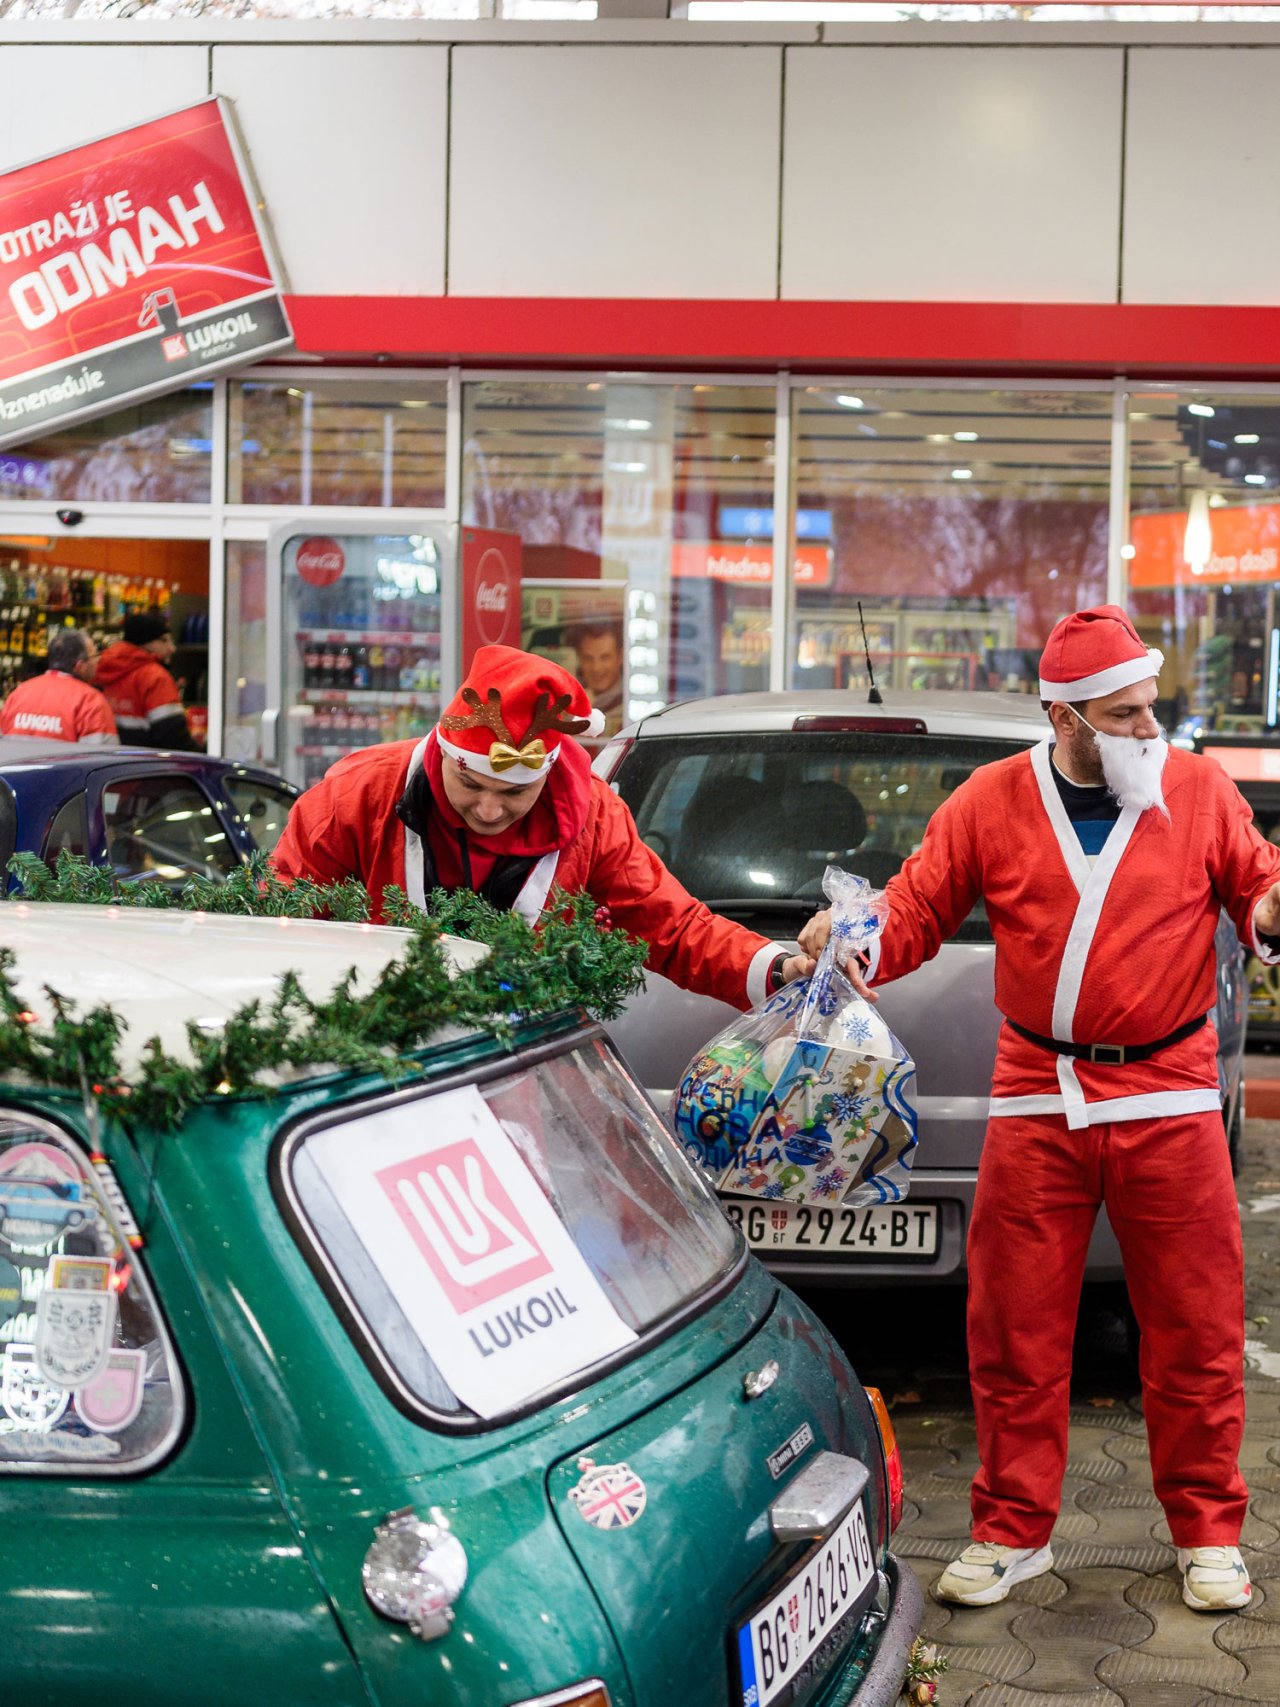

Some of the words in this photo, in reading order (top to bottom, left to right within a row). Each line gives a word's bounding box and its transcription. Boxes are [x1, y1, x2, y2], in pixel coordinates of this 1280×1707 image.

[104, 189, 135, 227] JE
[7, 181, 226, 331] ODMAH
[185, 312, 258, 352] LUKOIL
[707, 556, 771, 578] hladna
[14, 712, 63, 734] LUKOIL
[683, 1141, 783, 1172] ОДИНА
[468, 1287, 578, 1358] LUKOIL
[759, 1605, 789, 1691] BG
